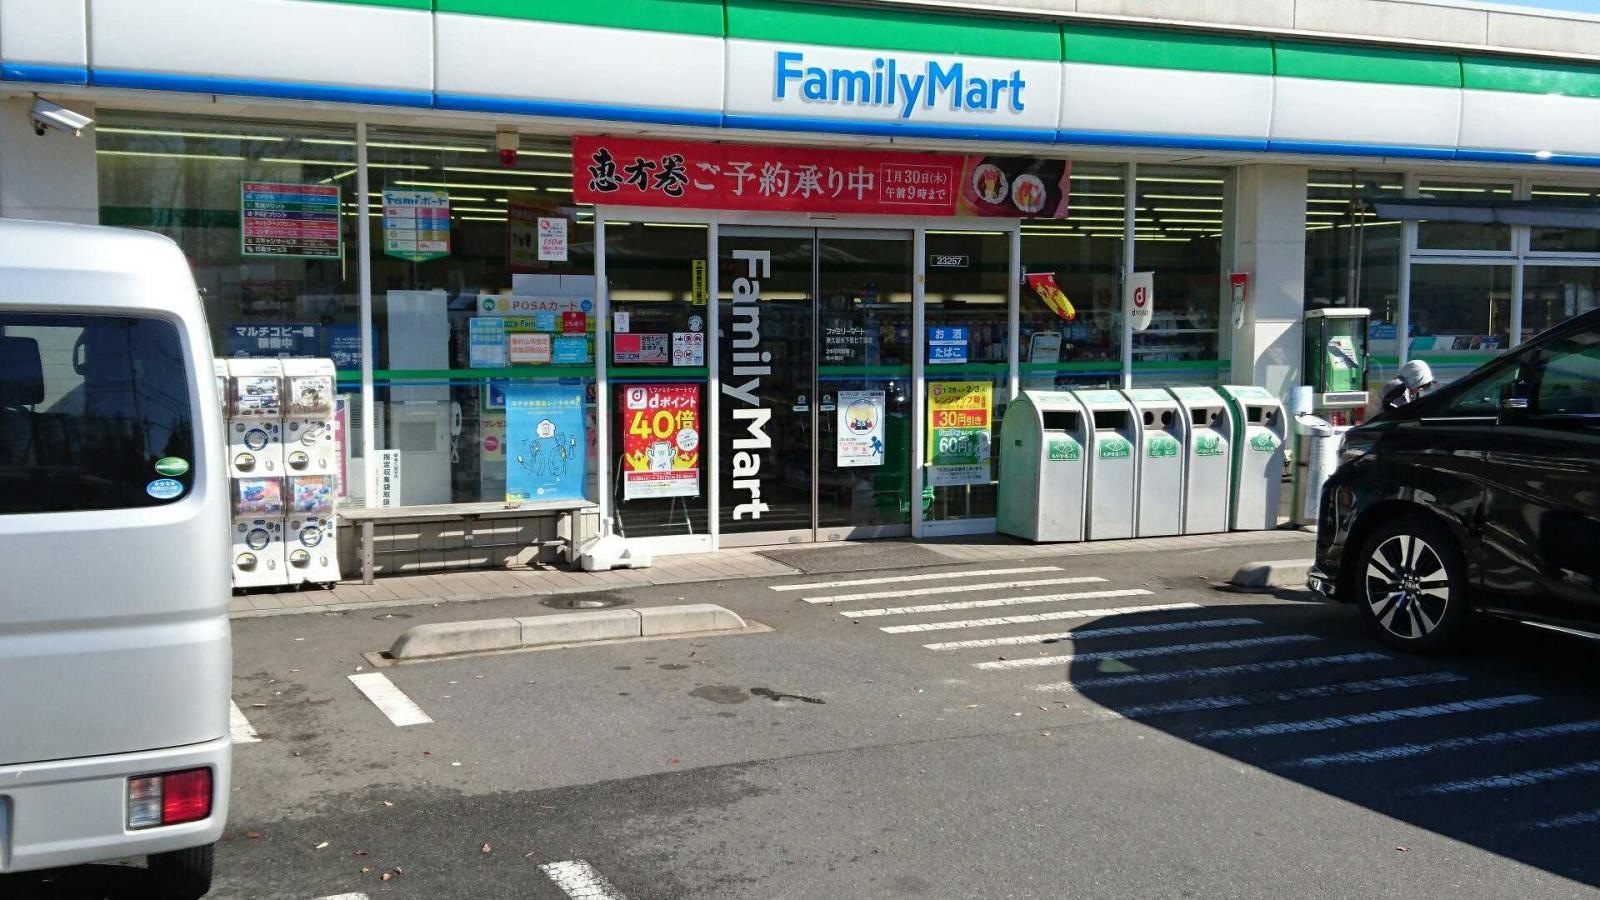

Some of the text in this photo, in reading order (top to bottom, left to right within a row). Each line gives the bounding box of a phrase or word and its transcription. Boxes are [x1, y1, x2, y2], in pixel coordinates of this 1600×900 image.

[776, 51, 1026, 119] FamilyMart
[587, 147, 874, 201] 恵方巻 ご予約承り中
[885, 169, 947, 184] 1月30日(木)
[885, 185, 946, 200] 午前9時まで
[936, 256, 963, 266] 23257
[512, 301, 579, 311] POSAカード
[235, 326, 315, 338] マルチコピー機
[826, 327, 866, 336] ファミリーマート
[935, 328, 963, 340] お酒
[257, 337, 294, 349] 稼働中
[616, 353, 640, 361] SECOM
[935, 347, 961, 358] たばこ
[721, 250, 772, 521] FamilyMart
[648, 393, 697, 409] dポイント
[629, 409, 695, 440] 40倍
[939, 411, 983, 427] 30円引き
